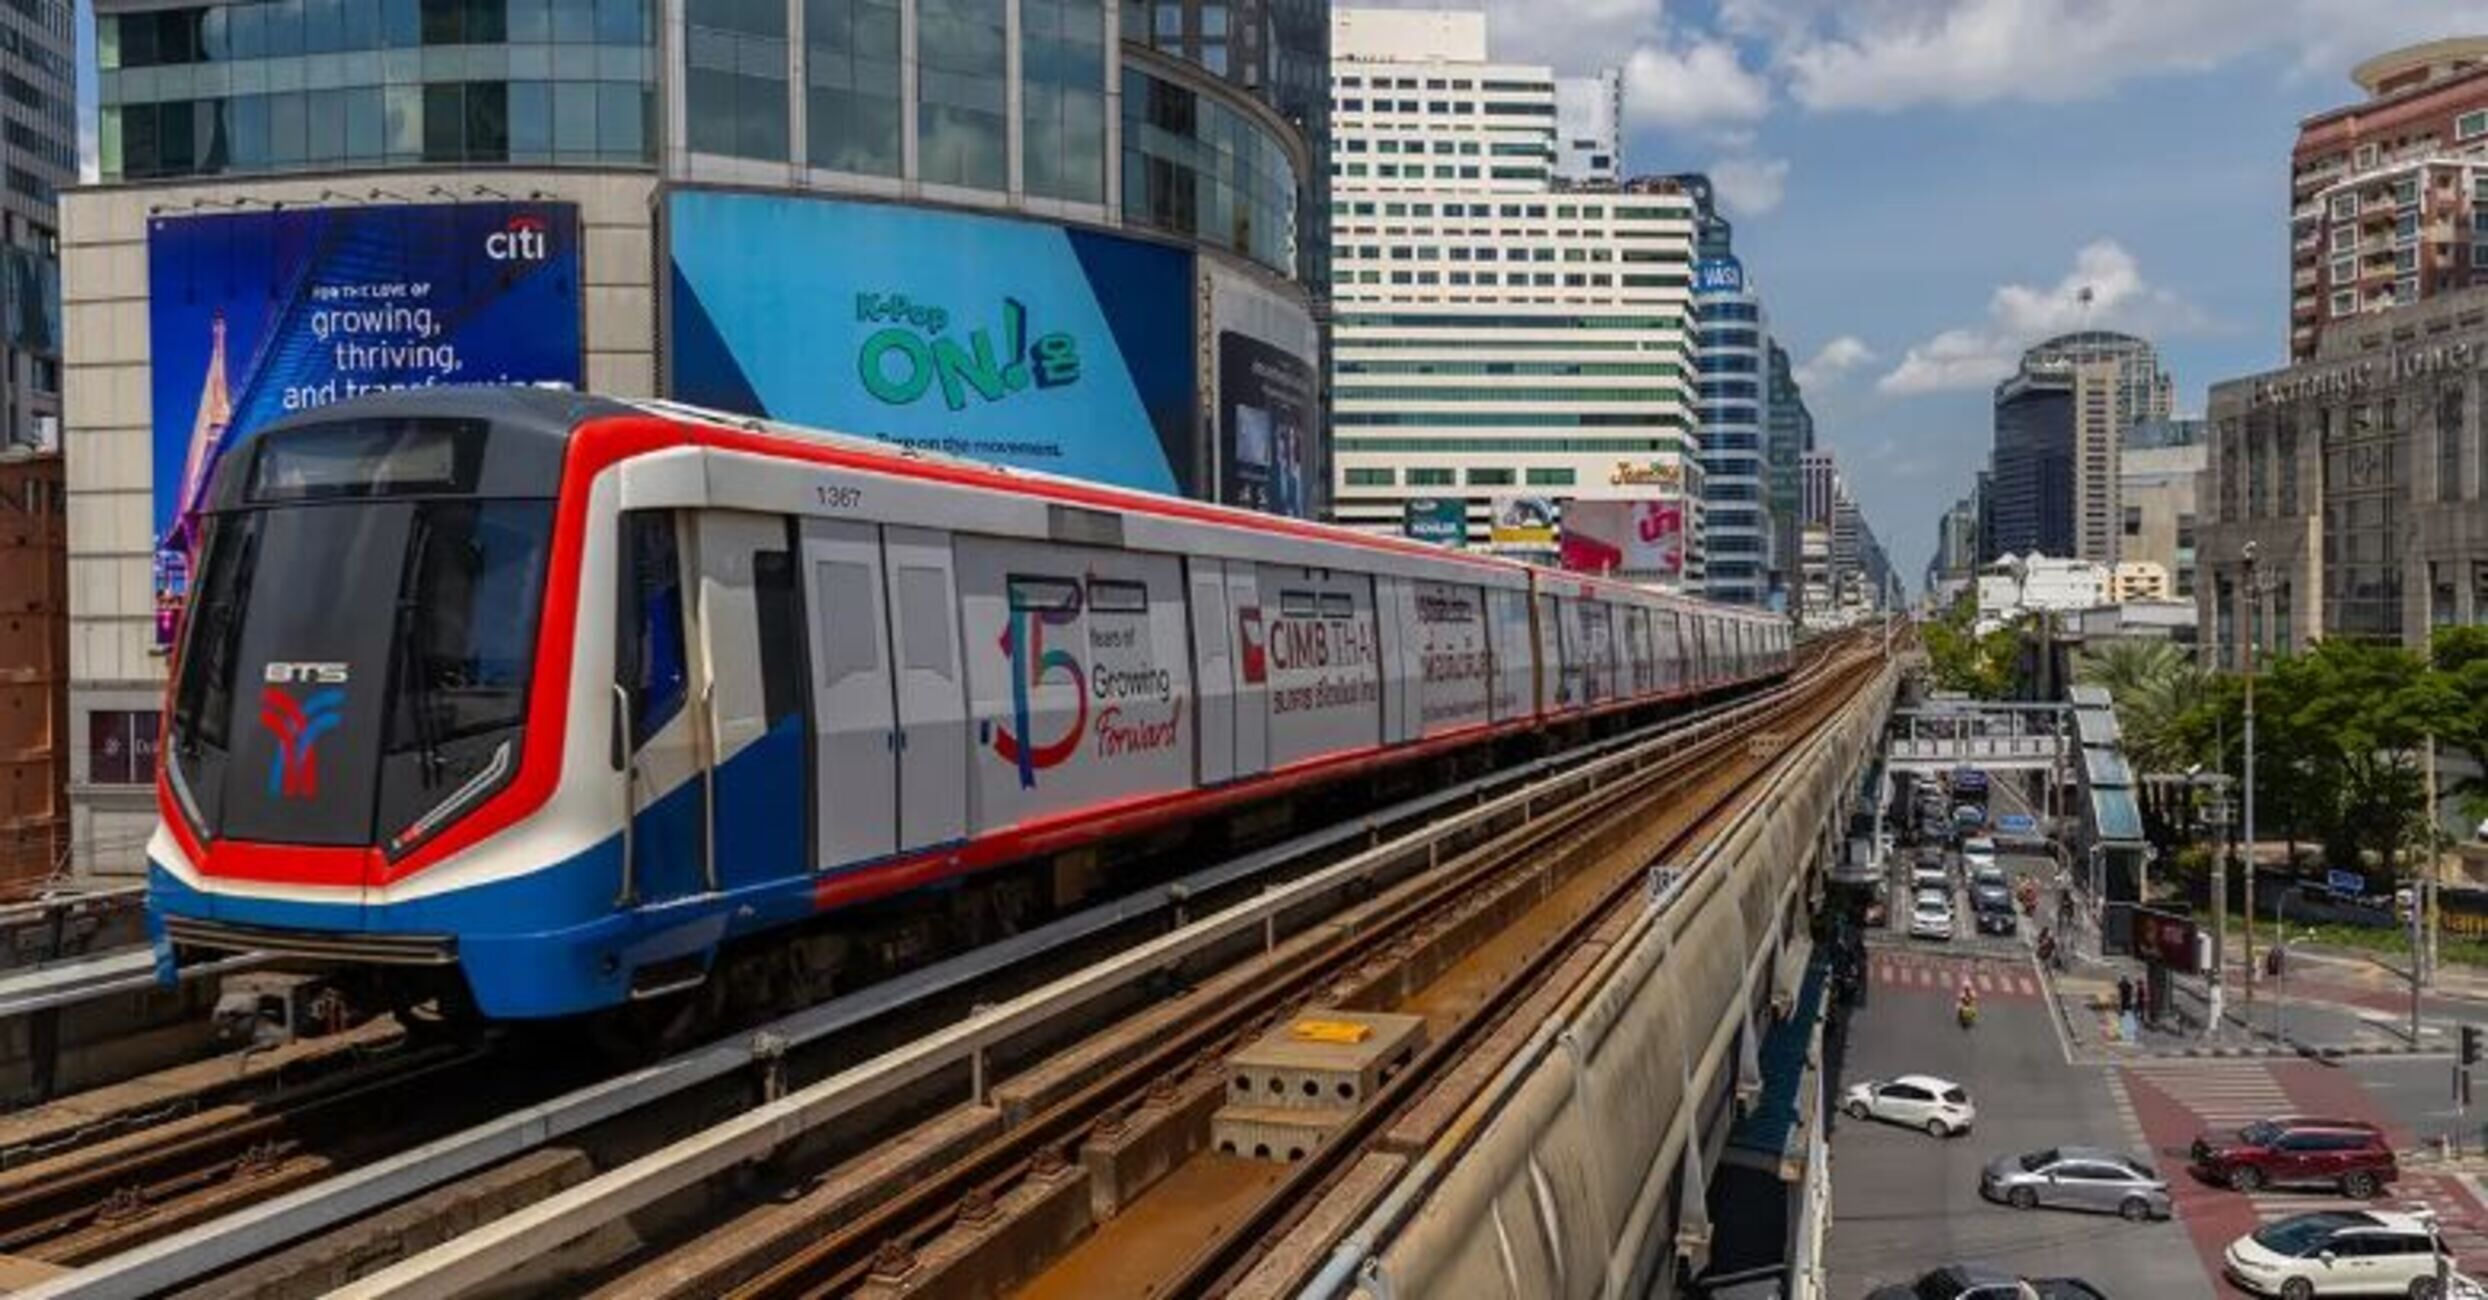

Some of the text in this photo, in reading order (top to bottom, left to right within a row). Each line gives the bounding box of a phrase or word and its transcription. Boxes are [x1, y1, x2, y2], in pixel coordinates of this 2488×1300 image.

[485, 224, 545, 259] citi
[371, 283, 407, 298] LOVE
[410, 282, 431, 297] OF
[311, 302, 440, 339] growing,
[856, 292, 948, 335] K-Pop
[335, 339, 463, 374] thriving,
[858, 296, 1030, 411] ON!
[282, 378, 336, 409] and
[816, 485, 861, 508] 1367
[1270, 620, 1329, 670] CIMB
[264, 662, 349, 682] BTS
[1092, 661, 1170, 703] Growing
[1095, 695, 1182, 758] Forward
